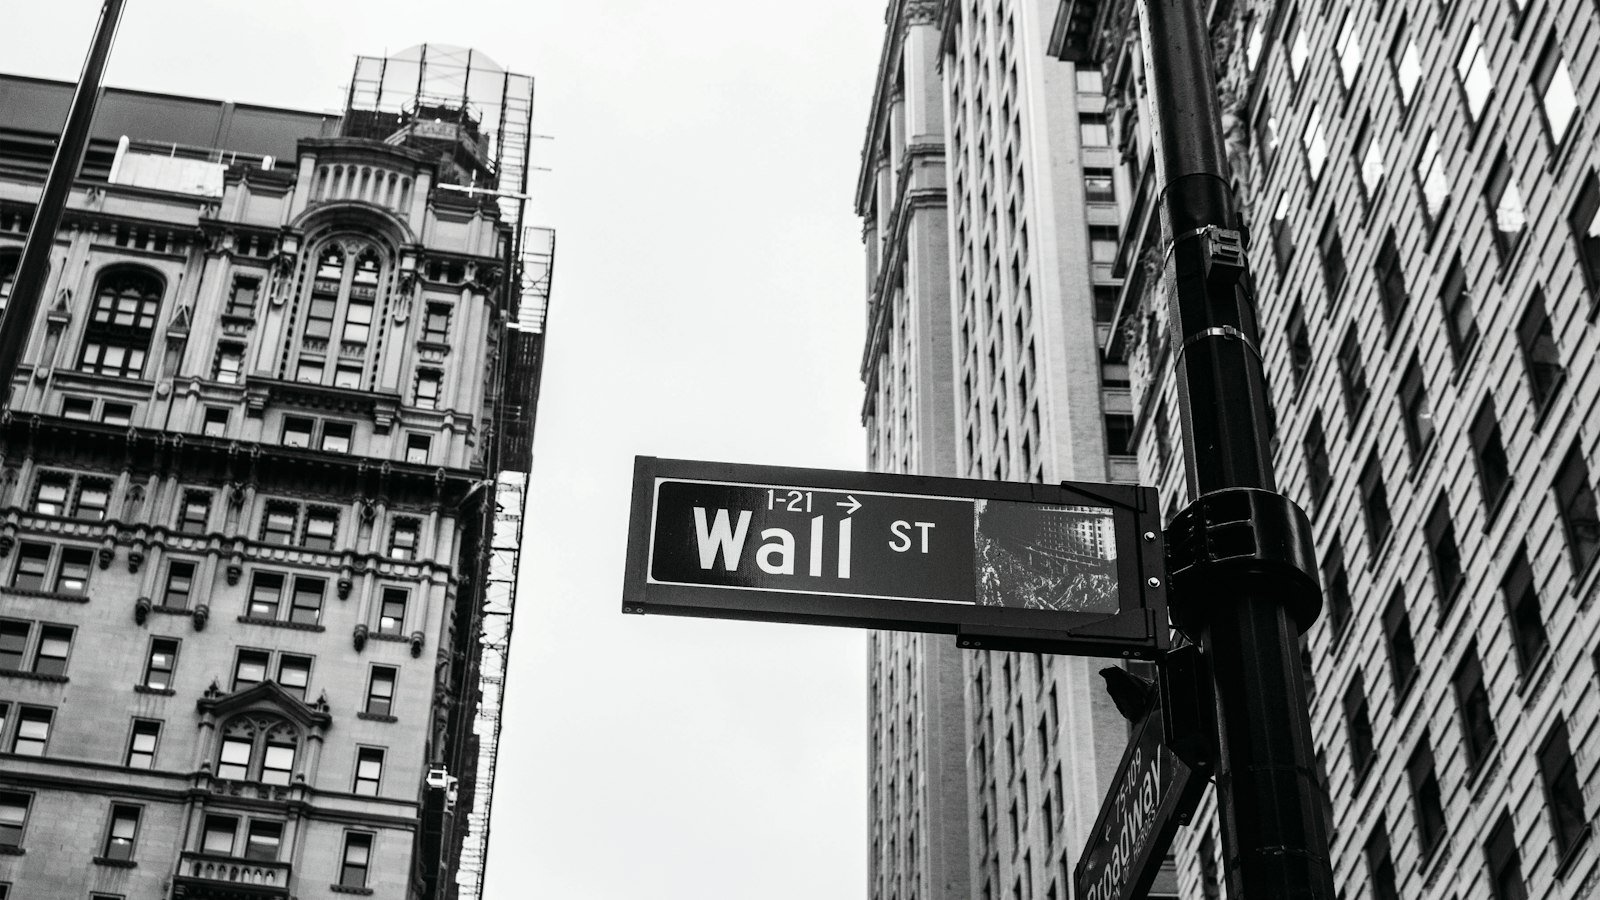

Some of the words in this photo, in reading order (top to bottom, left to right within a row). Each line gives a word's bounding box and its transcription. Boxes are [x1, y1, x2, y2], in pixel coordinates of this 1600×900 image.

[767, 489, 813, 513] 1-21
[693, 506, 852, 579] Wall
[888, 520, 935, 554] ST
[1115, 747, 1142, 823] 75-109
